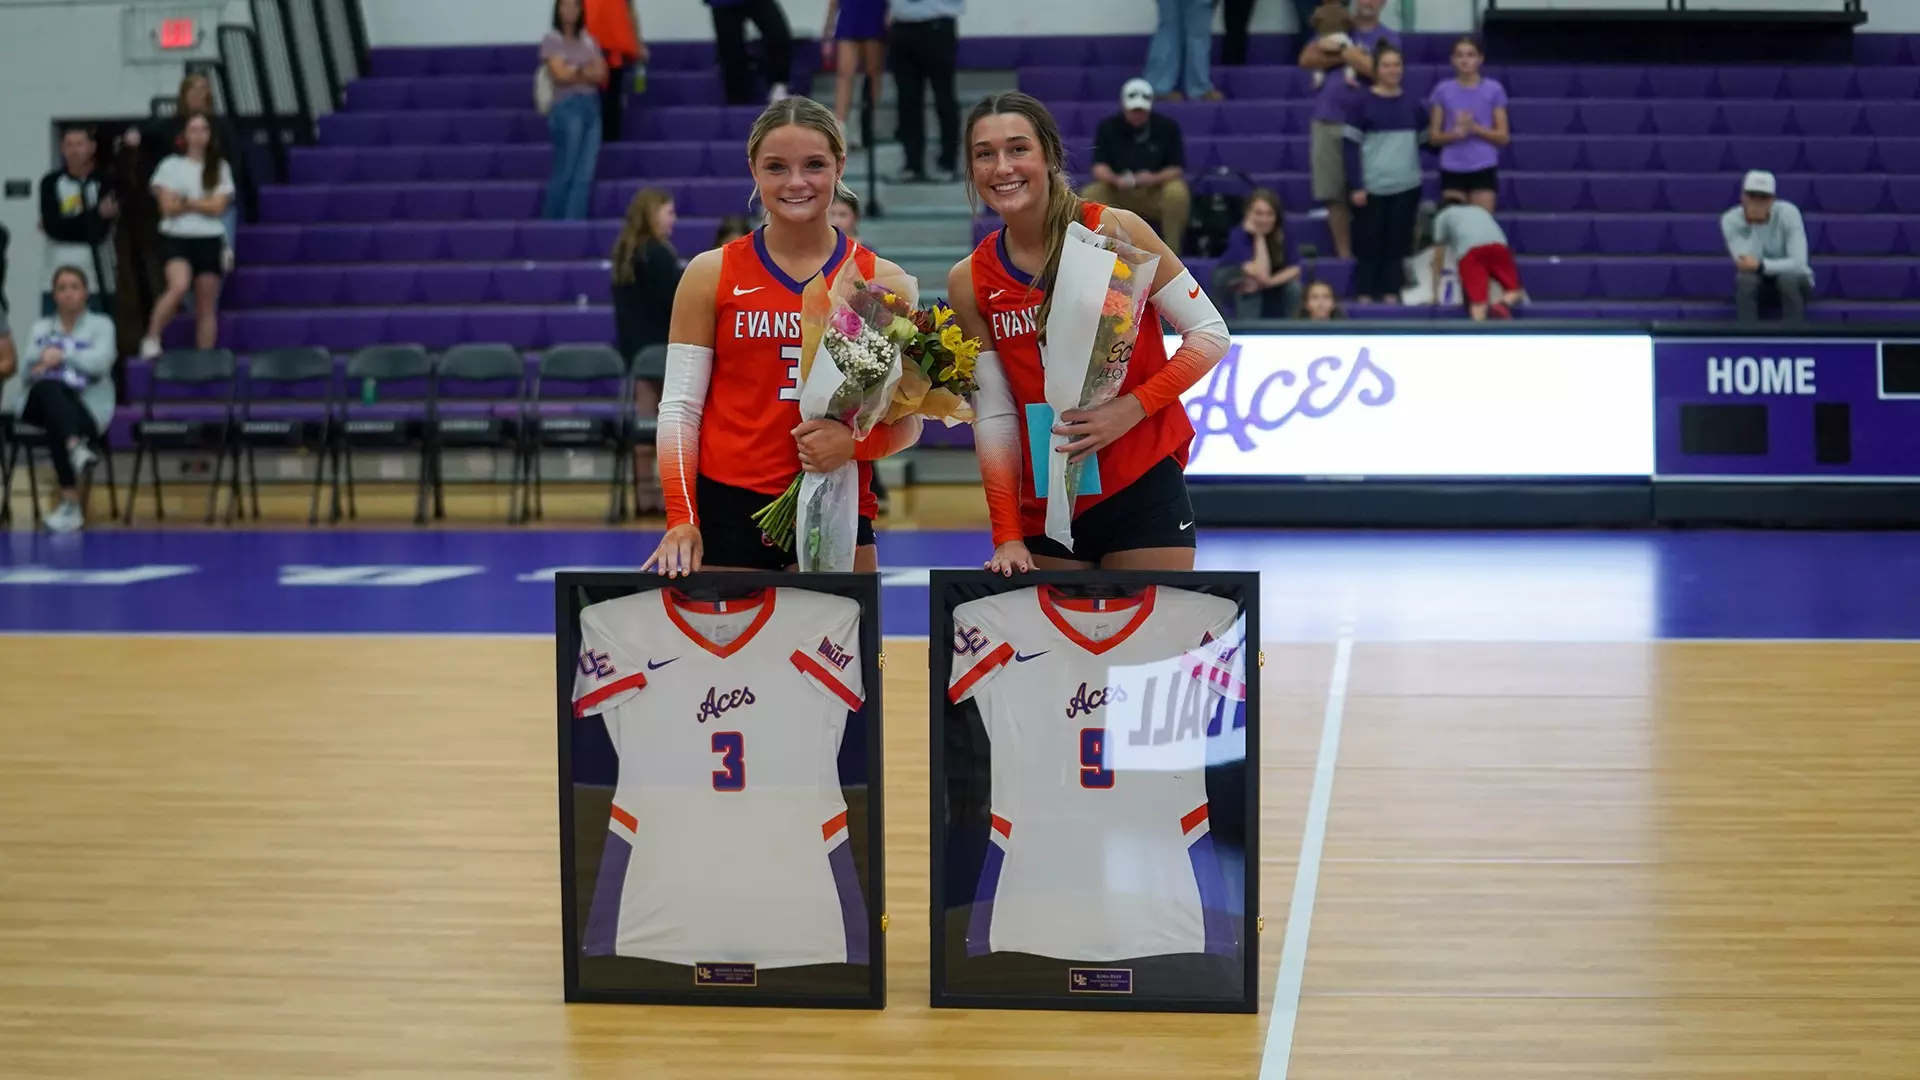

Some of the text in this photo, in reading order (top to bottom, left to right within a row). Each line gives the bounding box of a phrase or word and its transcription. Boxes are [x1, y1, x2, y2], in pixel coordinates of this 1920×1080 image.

[735, 311, 801, 338] EVANS
[778, 344, 802, 401] 3
[1707, 356, 1816, 395] HOME
[579, 648, 617, 681] UE
[711, 731, 746, 792] 3
[1080, 728, 1115, 789] 9
